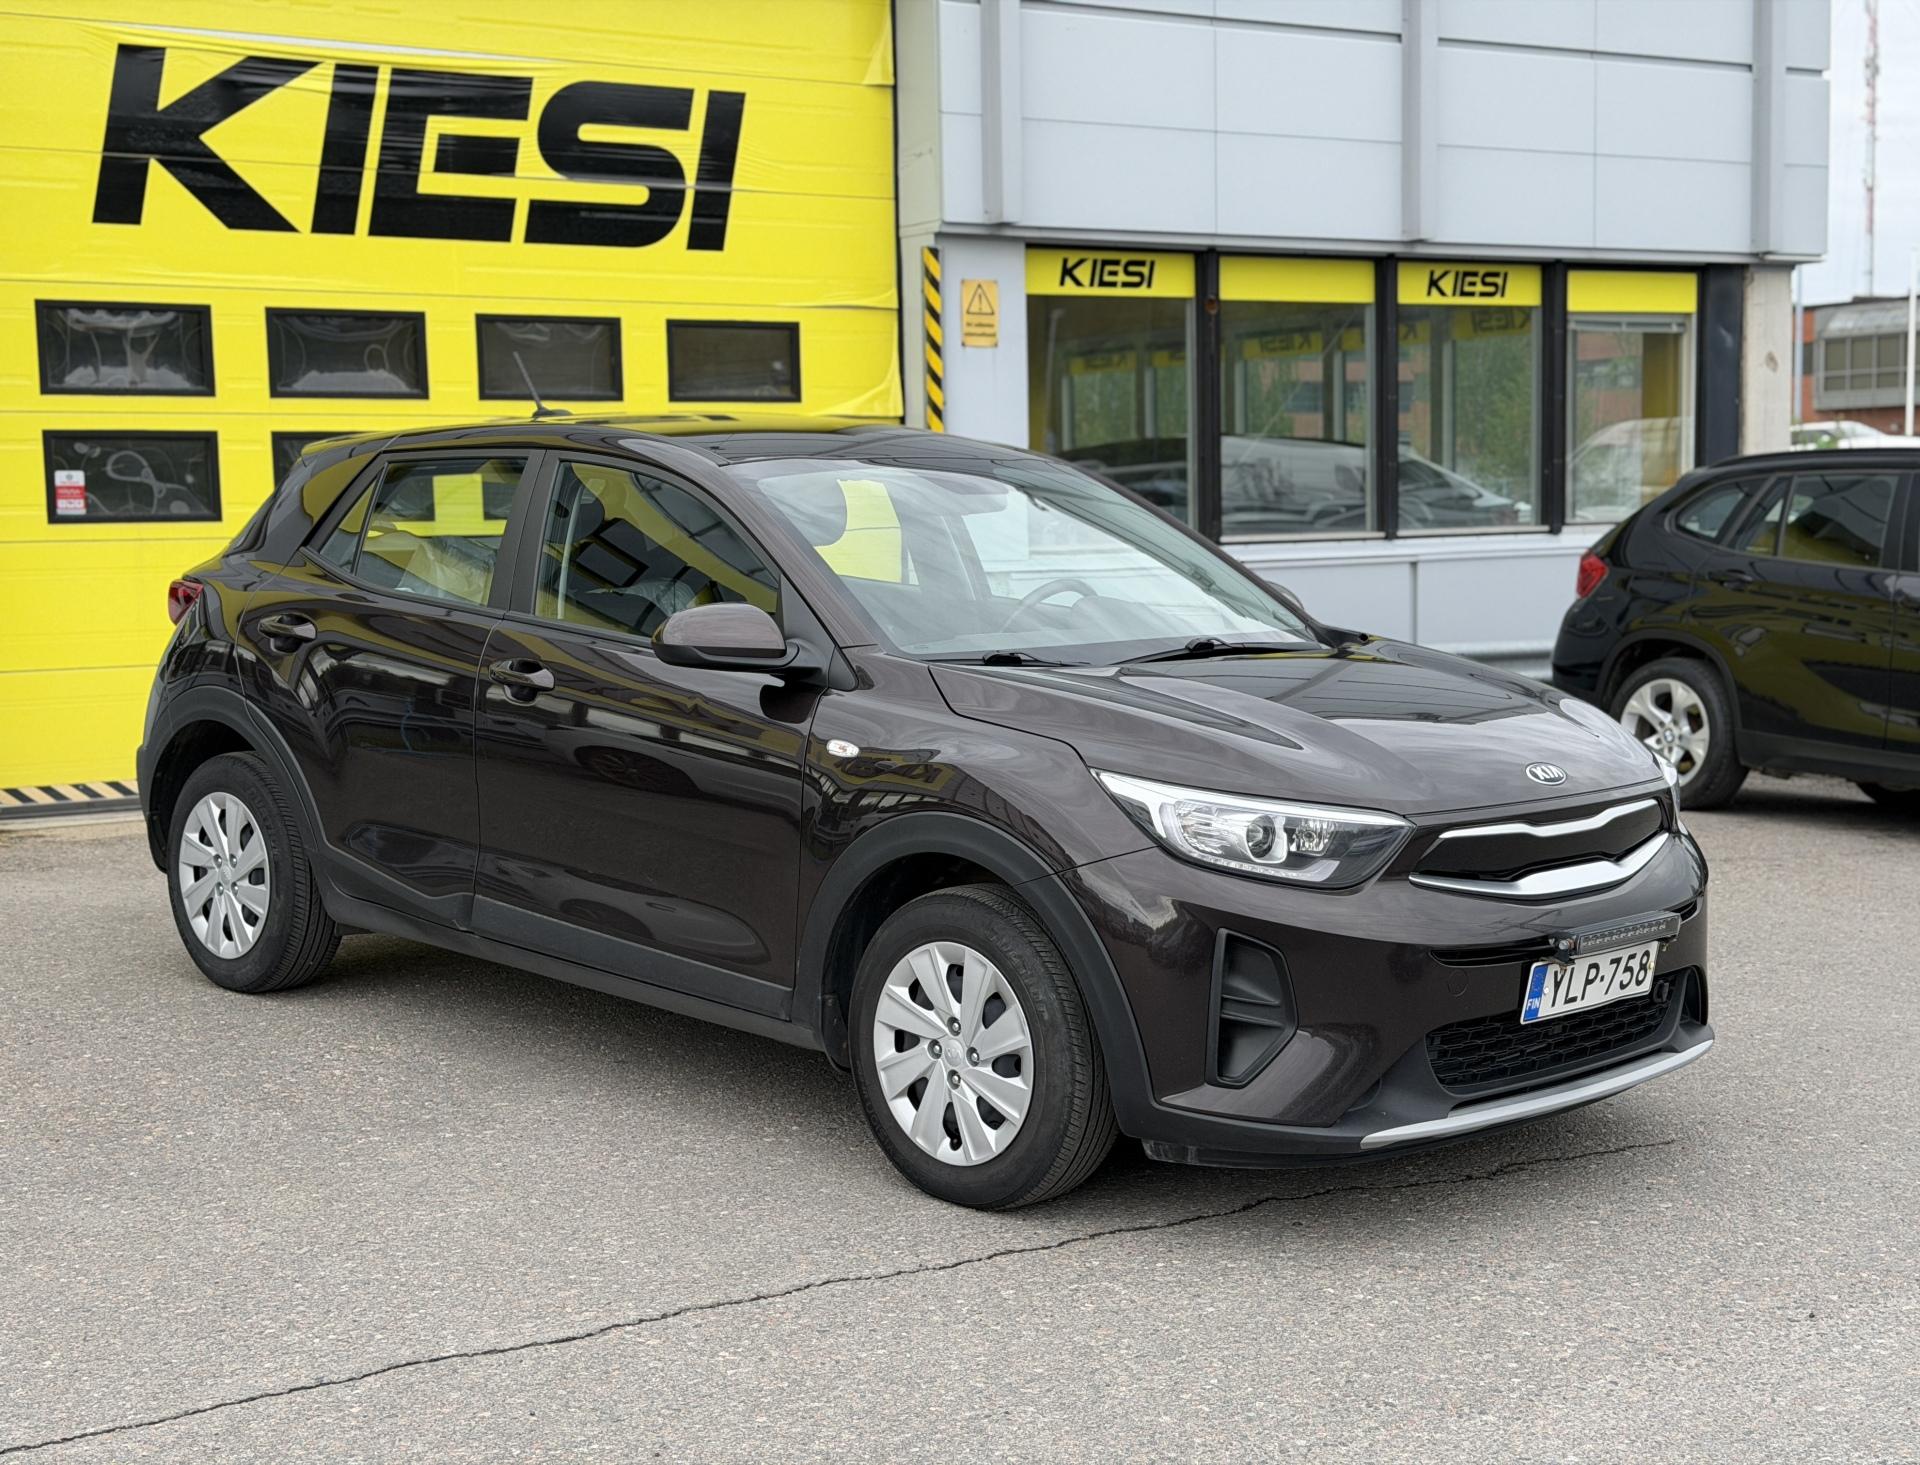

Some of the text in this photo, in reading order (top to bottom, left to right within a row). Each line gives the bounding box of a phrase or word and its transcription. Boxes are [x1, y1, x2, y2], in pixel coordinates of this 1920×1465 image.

[92, 43, 746, 251] KIESI
[1059, 257, 1155, 288] KIESI
[1427, 269, 1508, 298] KIESI
[1531, 765, 1564, 780] KIA
[1550, 949, 1651, 1008] YLP-758
[1526, 998, 1541, 1011] FIN
